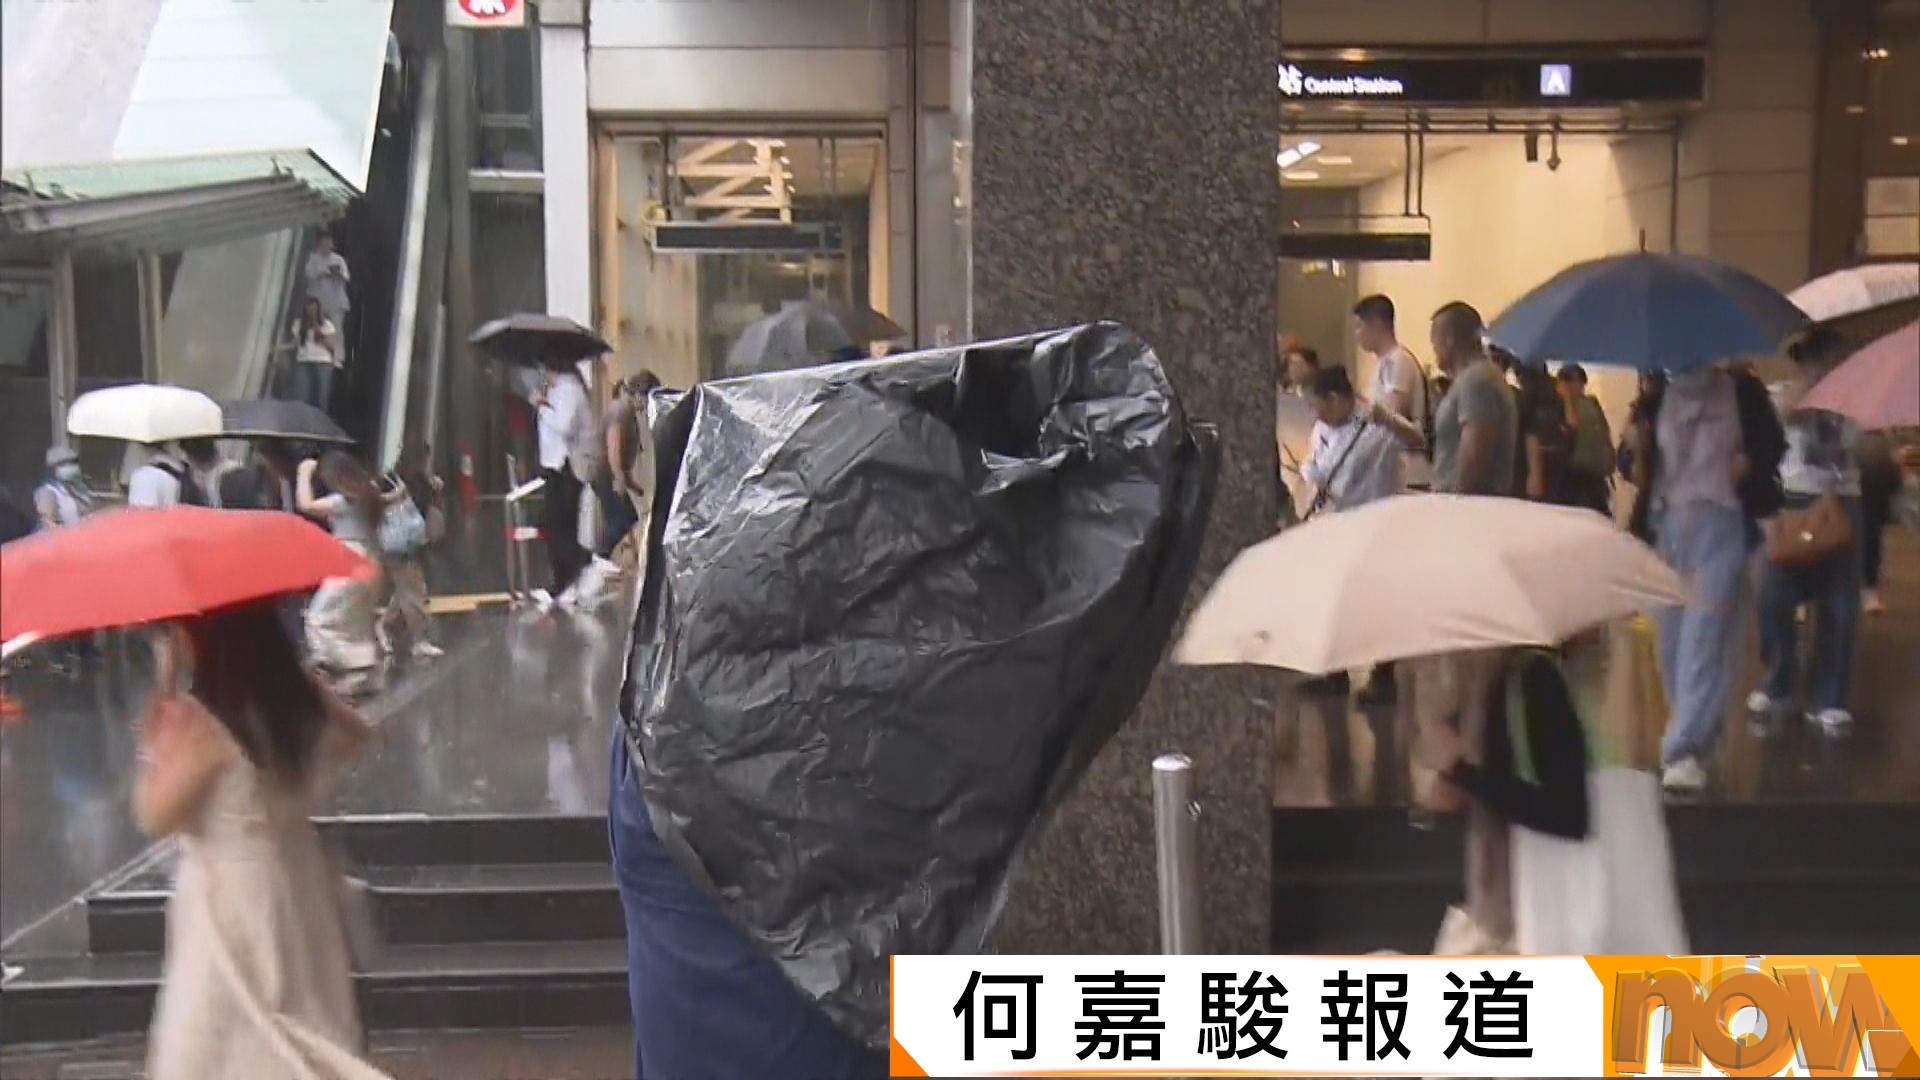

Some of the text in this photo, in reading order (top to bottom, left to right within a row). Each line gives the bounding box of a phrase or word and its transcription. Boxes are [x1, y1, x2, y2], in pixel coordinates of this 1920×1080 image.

[1304, 76, 1403, 96] Central Station
[1547, 69, 1567, 90] A
